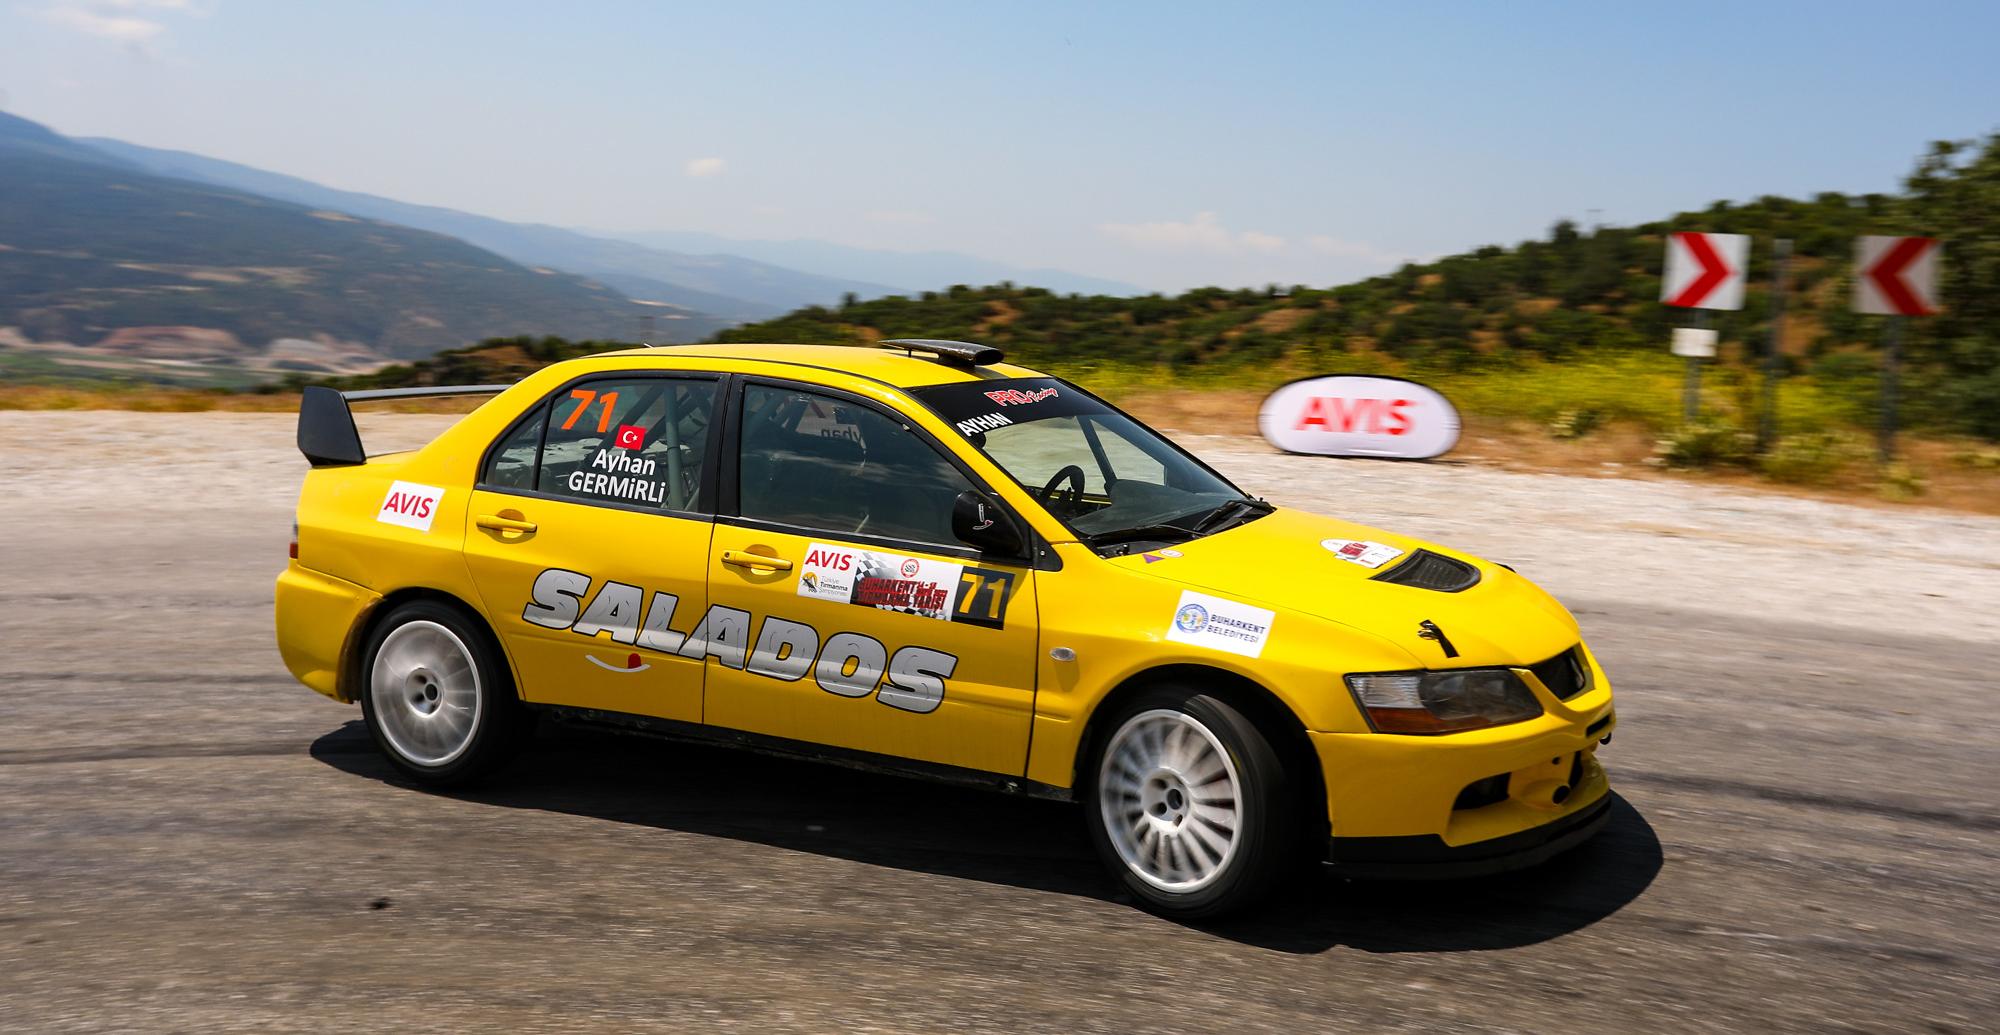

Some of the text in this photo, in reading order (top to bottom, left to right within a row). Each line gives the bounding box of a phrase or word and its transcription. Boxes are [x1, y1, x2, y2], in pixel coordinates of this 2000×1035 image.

[561, 389, 619, 433] 71
[984, 389, 1033, 407] PRO
[956, 412, 1014, 437] AYHAN
[1294, 396, 1416, 436] AVIS
[592, 448, 656, 476] Ayhan
[383, 491, 434, 519] AVIS
[804, 549, 853, 571] AVIS
[959, 573, 1006, 619] 71
[1210, 614, 1266, 634] BUHARKENT
[522, 567, 959, 714] SALADOS
